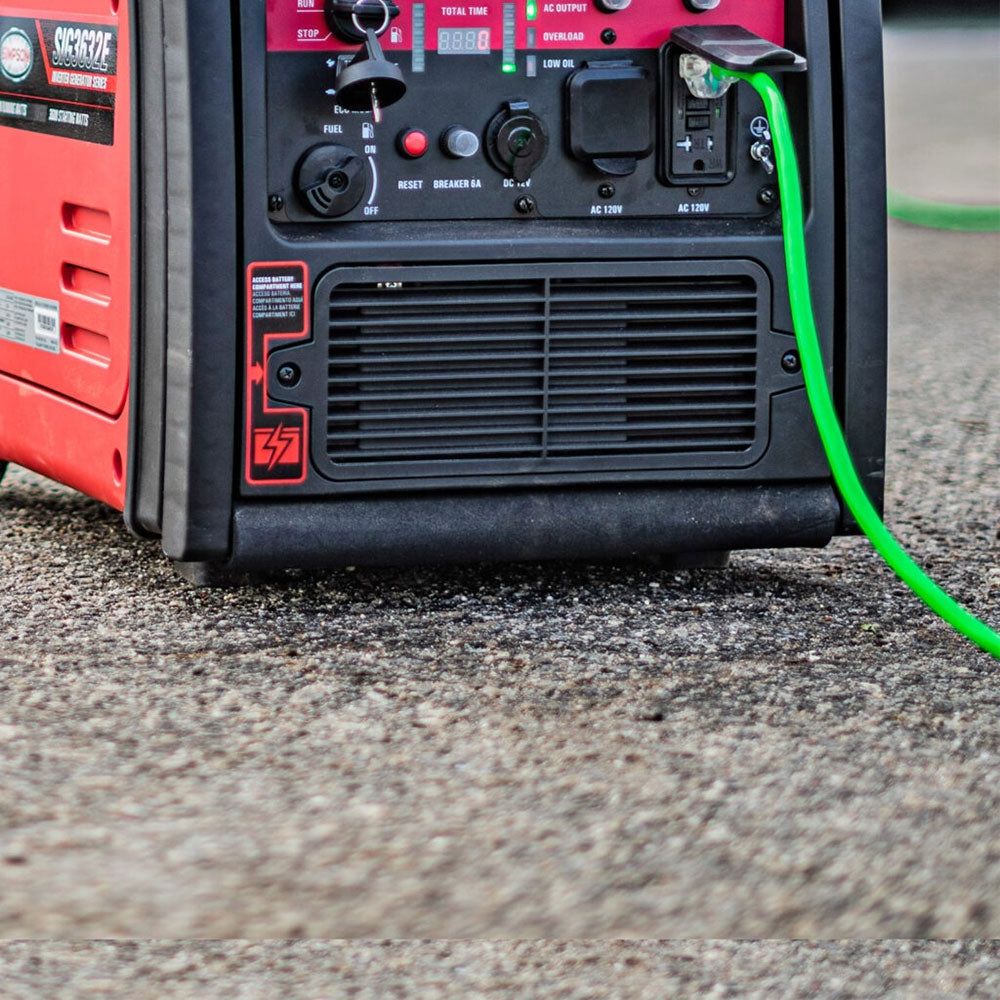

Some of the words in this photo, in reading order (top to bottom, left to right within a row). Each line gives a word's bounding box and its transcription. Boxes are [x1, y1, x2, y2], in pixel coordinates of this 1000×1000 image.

[297, 0, 315, 8] RUN
[543, 4, 554, 12] AC
[556, 4, 587, 12] OUTPUT
[441, 6, 466, 16] TOTAL
[468, 6, 488, 16] TIME
[297, 30, 319, 38] STOP
[543, 32, 584, 41] OVERLOAD
[52, 26, 112, 71] SIG3632E
[543, 59, 559, 68] LOW
[561, 59, 575, 68] OIL
[323, 125, 343, 133] FUEL
[364, 145, 376, 154] ON
[398, 180, 423, 189] RESET
[433, 180, 469, 189] BREAKER
[471, 180, 481, 188] 6A
[503, 179, 514, 187] DC
[364, 207, 379, 215] OFF
[590, 206, 602, 214] AC
[603, 206, 623, 214] 120V
[678, 204, 689, 212] AC
[690, 204, 709, 212] 120V
